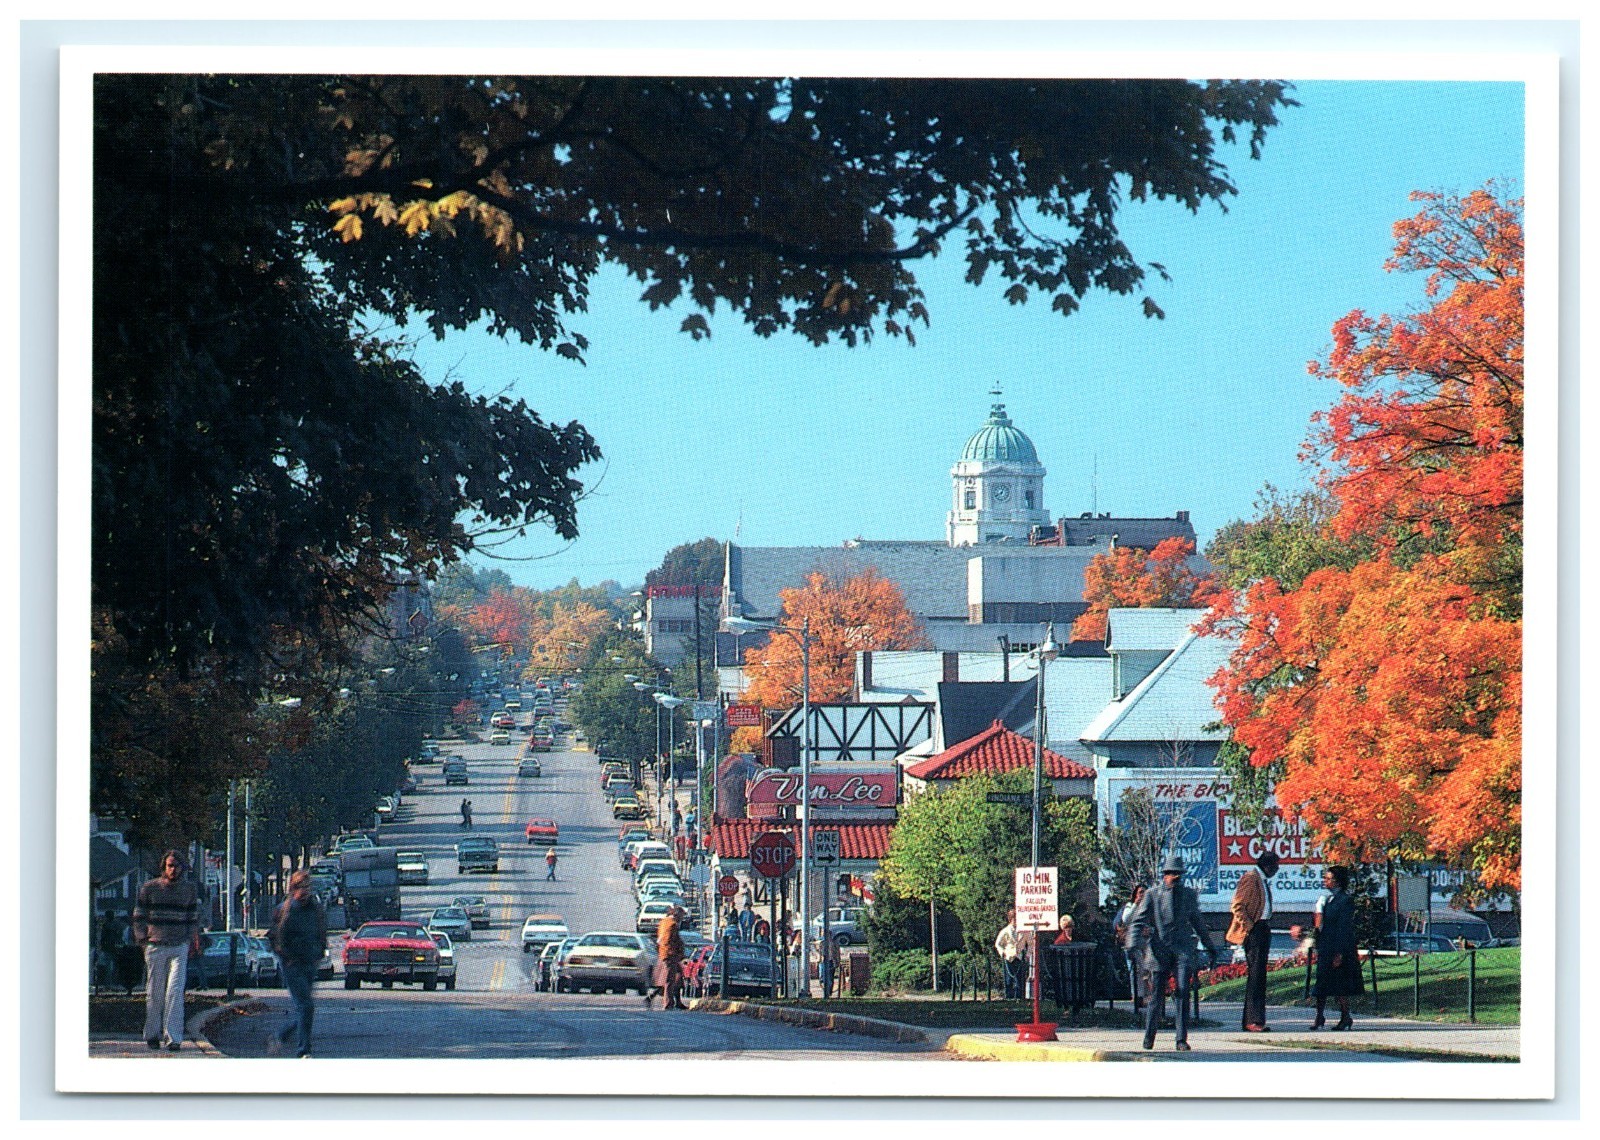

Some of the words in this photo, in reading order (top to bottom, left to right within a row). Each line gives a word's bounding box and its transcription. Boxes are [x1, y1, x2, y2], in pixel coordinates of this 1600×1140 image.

[830, 777, 883, 801] Lee
[1155, 784, 1191, 797] THE
[816, 833, 838, 843] ONE
[816, 843, 838, 852] WAY
[755, 847, 793, 864] STOP
[1023, 873, 1032, 884] 10
[1278, 871, 1288, 879] at
[719, 882, 738, 891] STOP
[1020, 885, 1053, 895] PARKING
